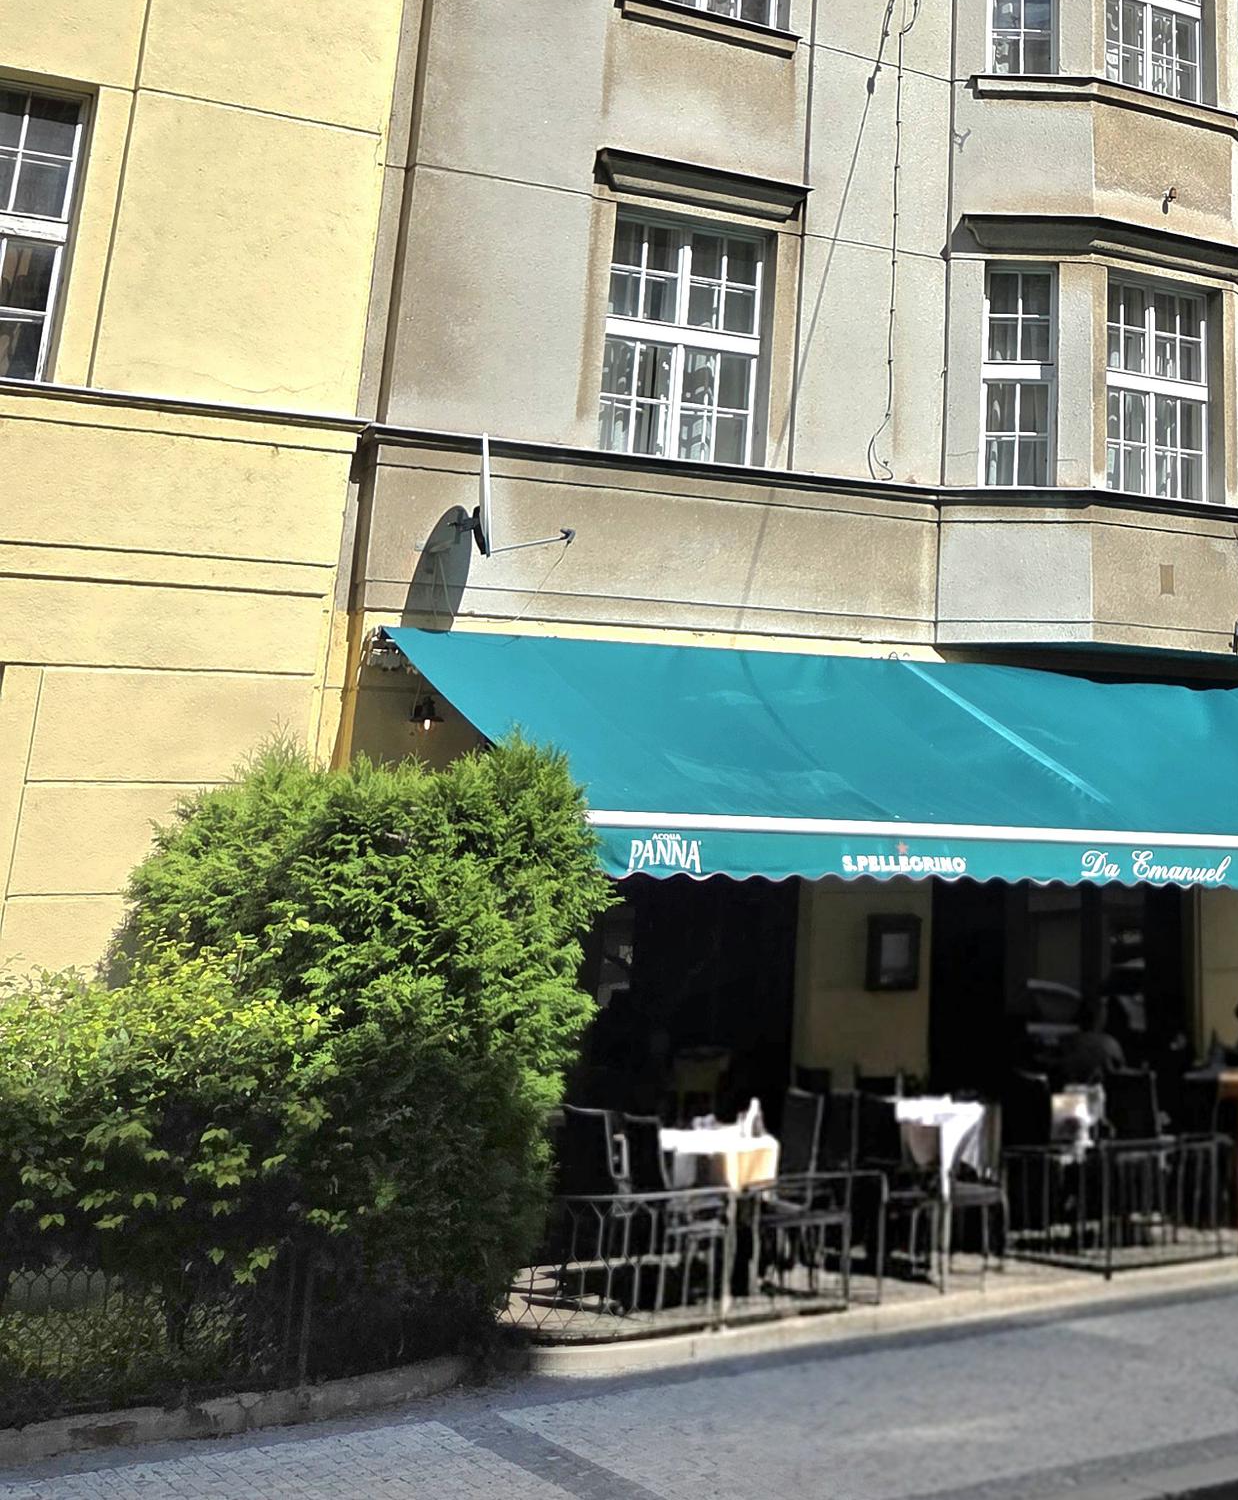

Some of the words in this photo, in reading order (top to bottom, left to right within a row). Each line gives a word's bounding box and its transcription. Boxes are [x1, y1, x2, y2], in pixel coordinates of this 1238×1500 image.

[652, 832, 682, 841] ACQUA
[627, 839, 702, 873] PANNA
[841, 855, 967, 873] S.PELLEGRINO
[1080, 850, 1121, 878] Da
[1131, 850, 1232, 882] Emanuel
